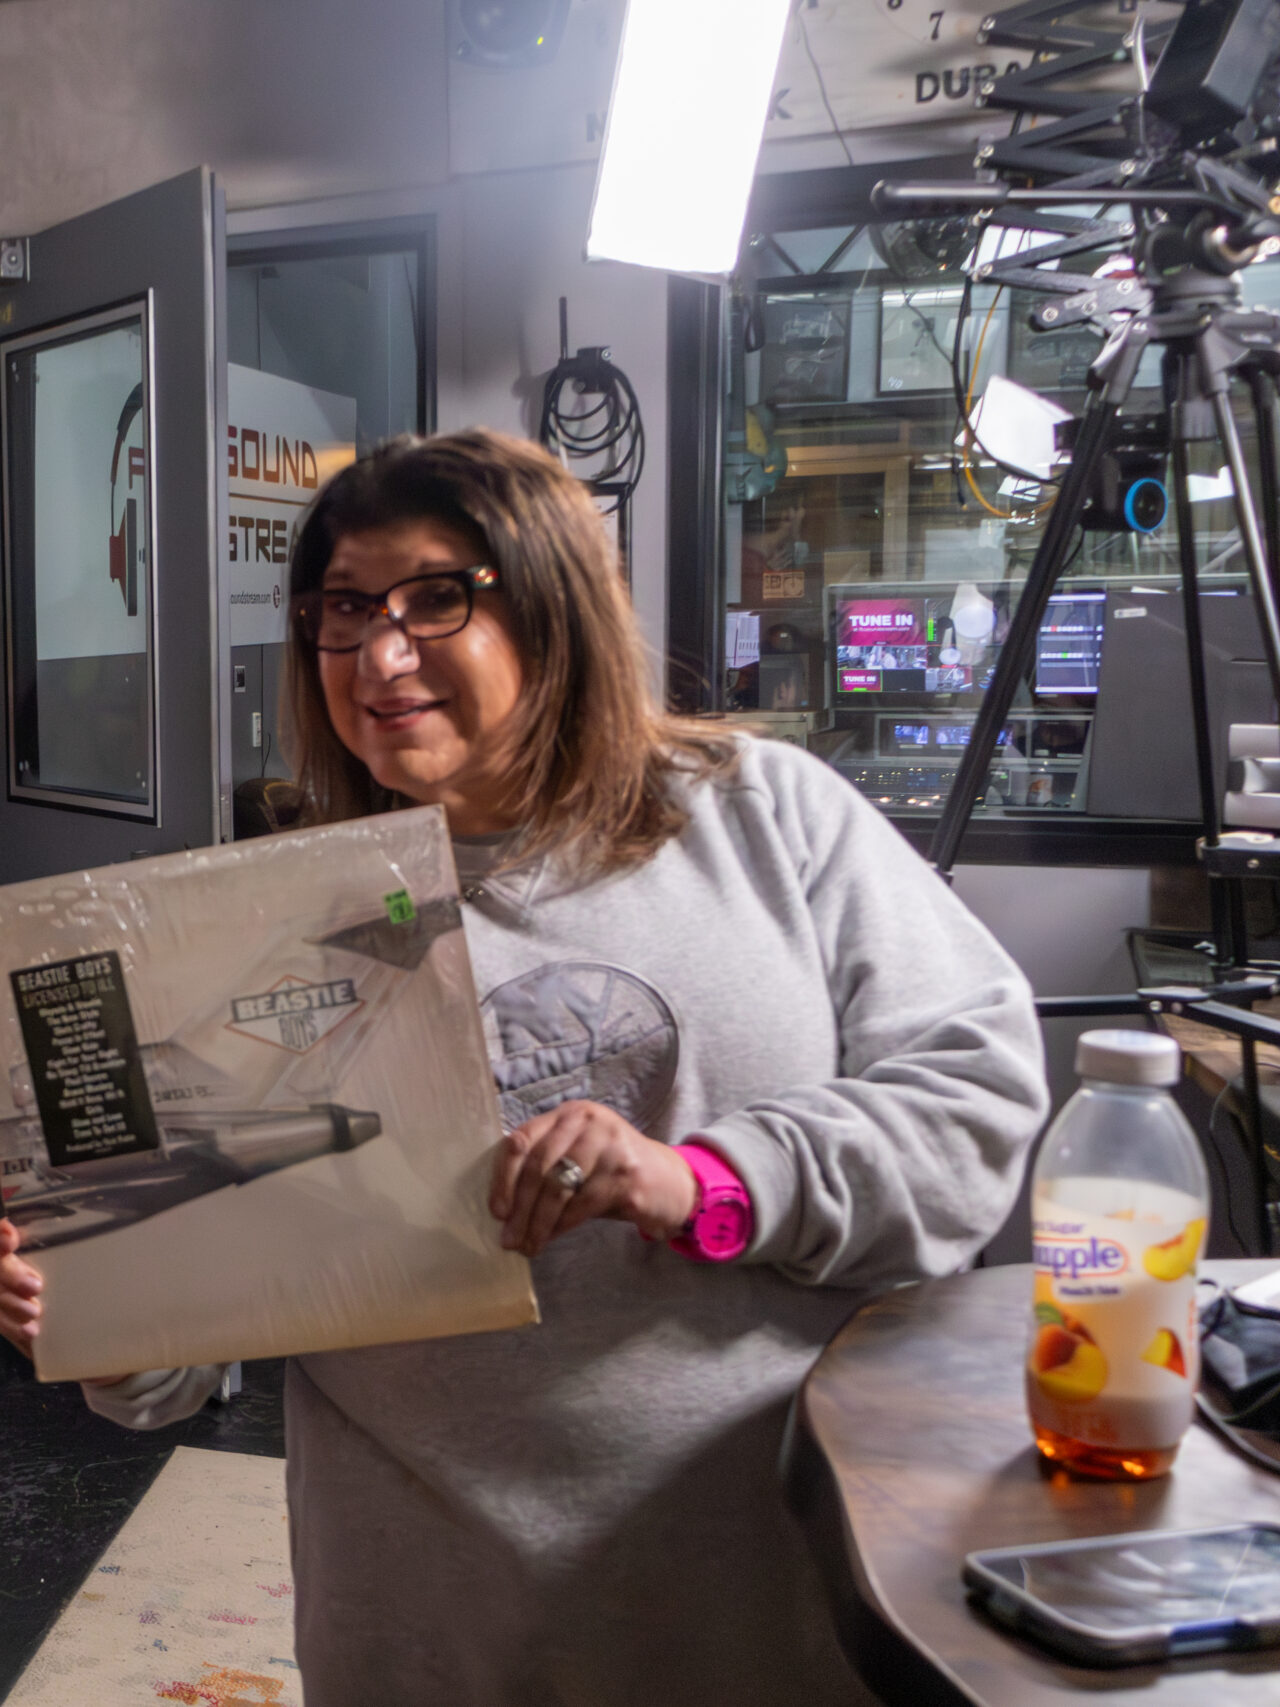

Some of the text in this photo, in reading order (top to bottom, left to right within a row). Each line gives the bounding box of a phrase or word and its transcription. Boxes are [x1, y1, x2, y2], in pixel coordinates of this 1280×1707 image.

[849, 614, 914, 627] TUNE IN
[18, 957, 112, 992] BEASTIE BOYS
[235, 982, 353, 1021] BEASTIE
[278, 1011, 319, 1049] BOYS
